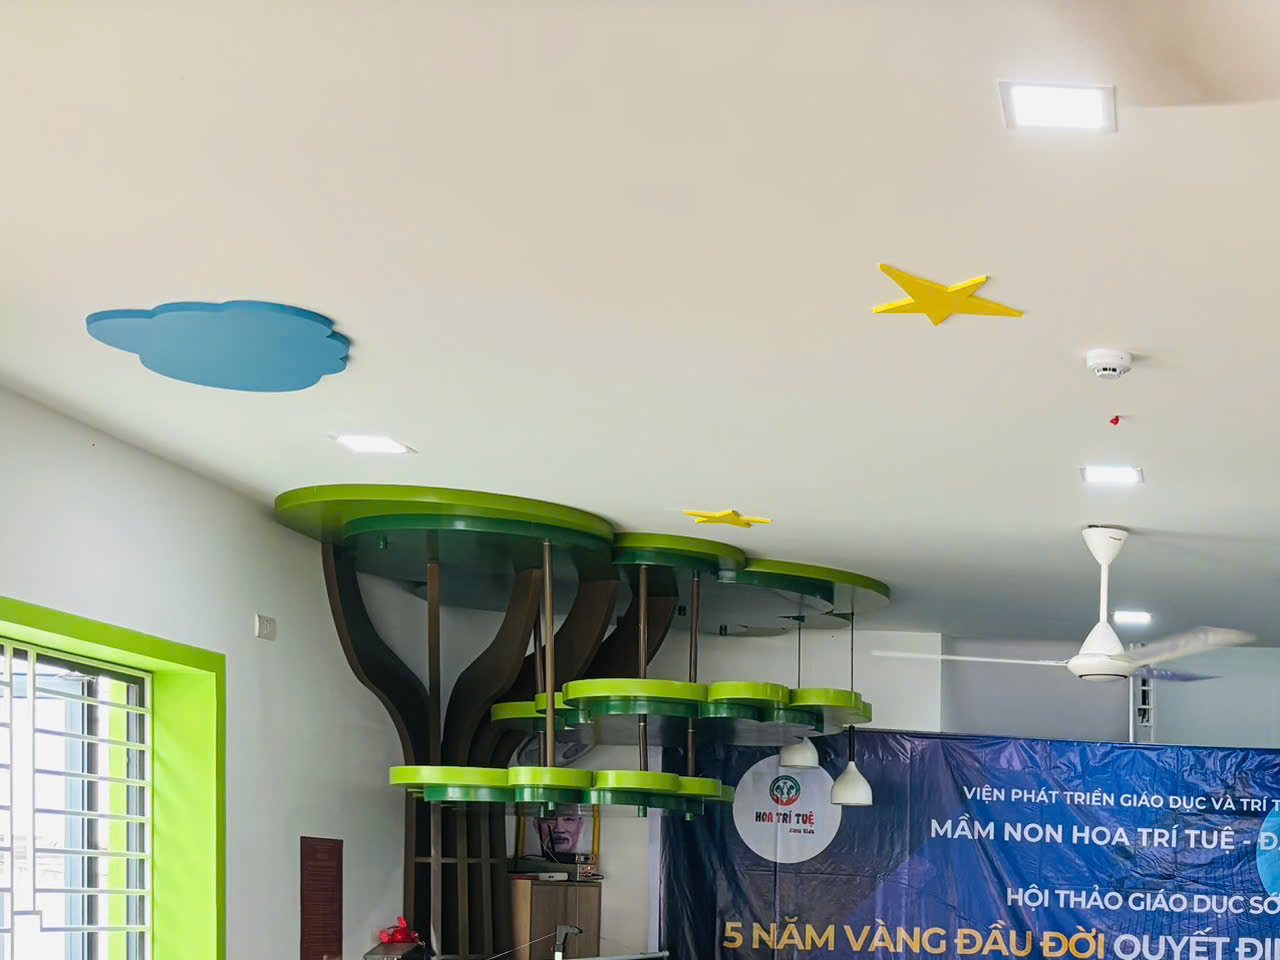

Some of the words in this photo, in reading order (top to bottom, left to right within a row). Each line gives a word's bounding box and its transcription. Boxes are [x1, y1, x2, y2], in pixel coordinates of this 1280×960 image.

[963, 784, 1005, 804] VIỆN
[1011, 787, 1059, 804] PHÁT
[1063, 788, 1114, 806] TRIỂN
[1119, 790, 1164, 808] GIÁO
[1169, 796, 1206, 813] DỤC
[1211, 795, 1236, 811] VÀ
[1240, 796, 1267, 812] TRÍ
[776, 811, 792, 824] TRÍ
[795, 811, 814, 827] TUỆ
[930, 813, 995, 840] MẦM
[1004, 822, 1063, 844] NON
[1072, 825, 1130, 846] HOA
[1137, 825, 1179, 848] TRÍ
[1184, 827, 1235, 854] TUỆ
[1007, 883, 1049, 911] HỘI
[1054, 885, 1123, 910] THẢO
[1128, 889, 1187, 912] GIÁO
[1193, 894, 1244, 918] DỤC
[722, 922, 744, 949] 5
[752, 916, 835, 951] NĂM
[843, 919, 947, 954] VÀNG
[954, 920, 1032, 957] ĐẦU
[1040, 925, 1104, 959] ĐỜI
